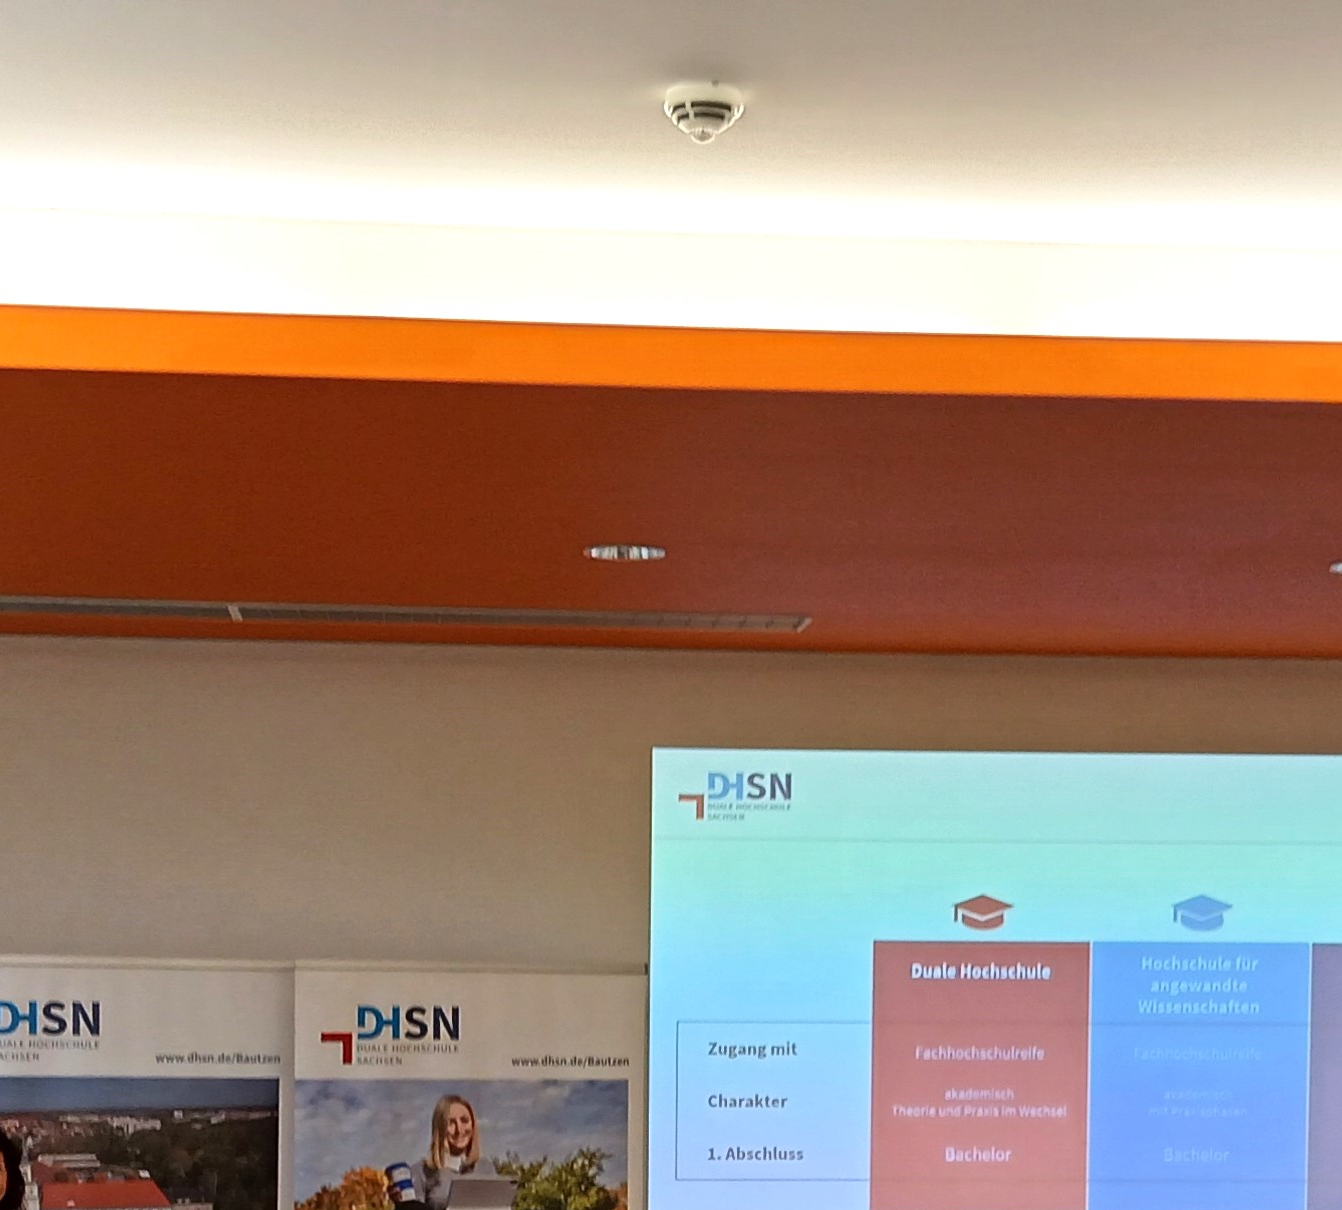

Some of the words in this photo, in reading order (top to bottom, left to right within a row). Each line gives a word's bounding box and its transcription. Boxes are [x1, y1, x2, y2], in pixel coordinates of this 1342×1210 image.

[707, 772, 793, 800] DHSN
[1141, 955, 1232, 971] Hochschule
[1235, 955, 1259, 971] für
[911, 962, 956, 980] Duale
[960, 962, 1051, 980] Hochschule
[1150, 978, 1248, 996] angewandte
[1138, 999, 1260, 1014] Wissenschaften
[358, 1005, 460, 1041] DHSN
[708, 1042, 767, 1059] Zugang
[770, 1041, 798, 1057] mit
[915, 1045, 1045, 1061] Fachhochschulreife
[155, 1052, 281, 1065] www.dhsn.de/Bautzen
[511, 1055, 630, 1068] www.dhsn.de/Bautzen
[708, 1094, 788, 1109] Charakter
[944, 1088, 1014, 1100] akademisch
[892, 1105, 936, 1118] Theorie
[938, 1105, 961, 1118] und
[964, 1105, 999, 1118] Praxis
[1001, 1105, 1016, 1118] im
[1019, 1105, 1067, 1118] Wechsel
[707, 1147, 722, 1161] 1.
[725, 1146, 804, 1161] Abschluss
[945, 1146, 1012, 1162] Bachelor
[1164, 1148, 1231, 1163] Bachelor
